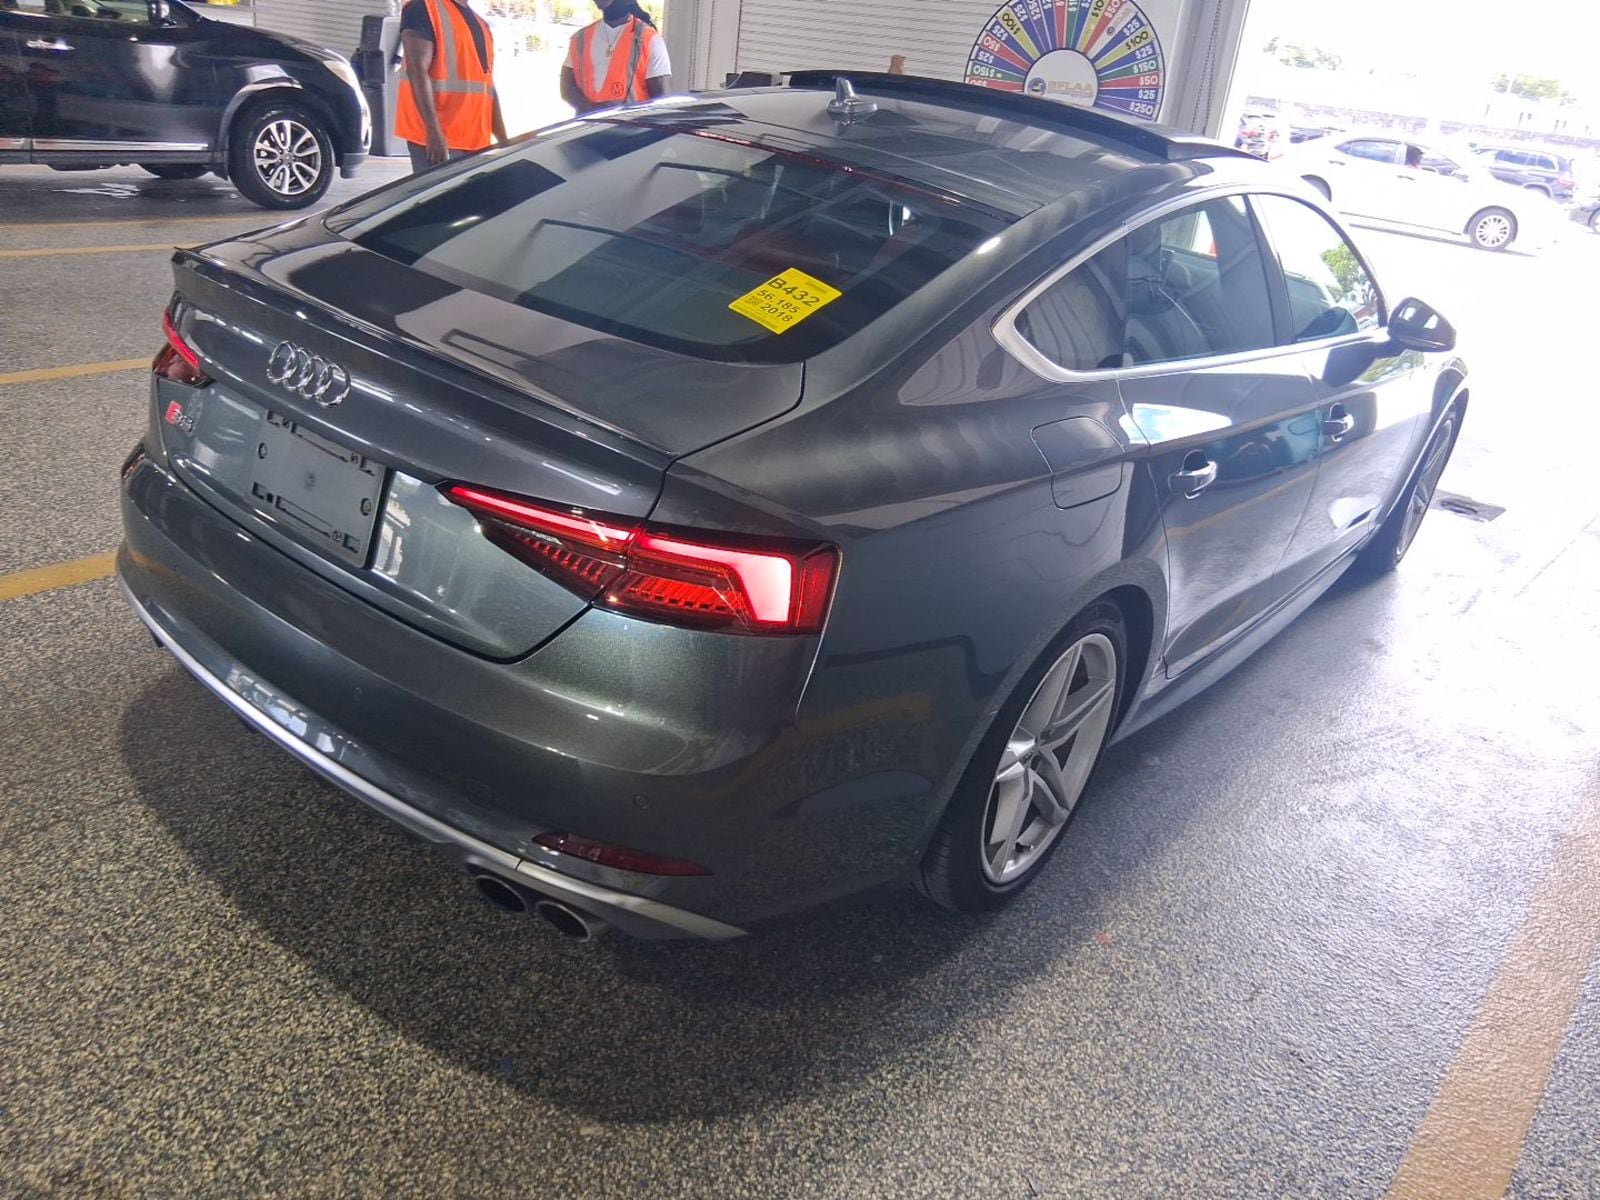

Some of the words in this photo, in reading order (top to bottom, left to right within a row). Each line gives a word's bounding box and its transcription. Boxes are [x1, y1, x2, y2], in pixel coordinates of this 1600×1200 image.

[1013, 4, 1028, 22] $25
[1002, 13, 1021, 35] $100
[1122, 19, 1140, 36] $25
[992, 25, 1008, 41] $25
[1125, 31, 1149, 50] $100
[983, 36, 1001, 52] $50
[978, 51, 995, 64] $25
[1134, 45, 1153, 60] $25
[973, 65, 995, 78] $150
[1132, 60, 1157, 74] $150
[1139, 75, 1159, 87] $50
[1138, 89, 1156, 101] $25
[1129, 101, 1154, 115] $250
[768, 278, 820, 307] B432
[761, 304, 793, 322] 2018
